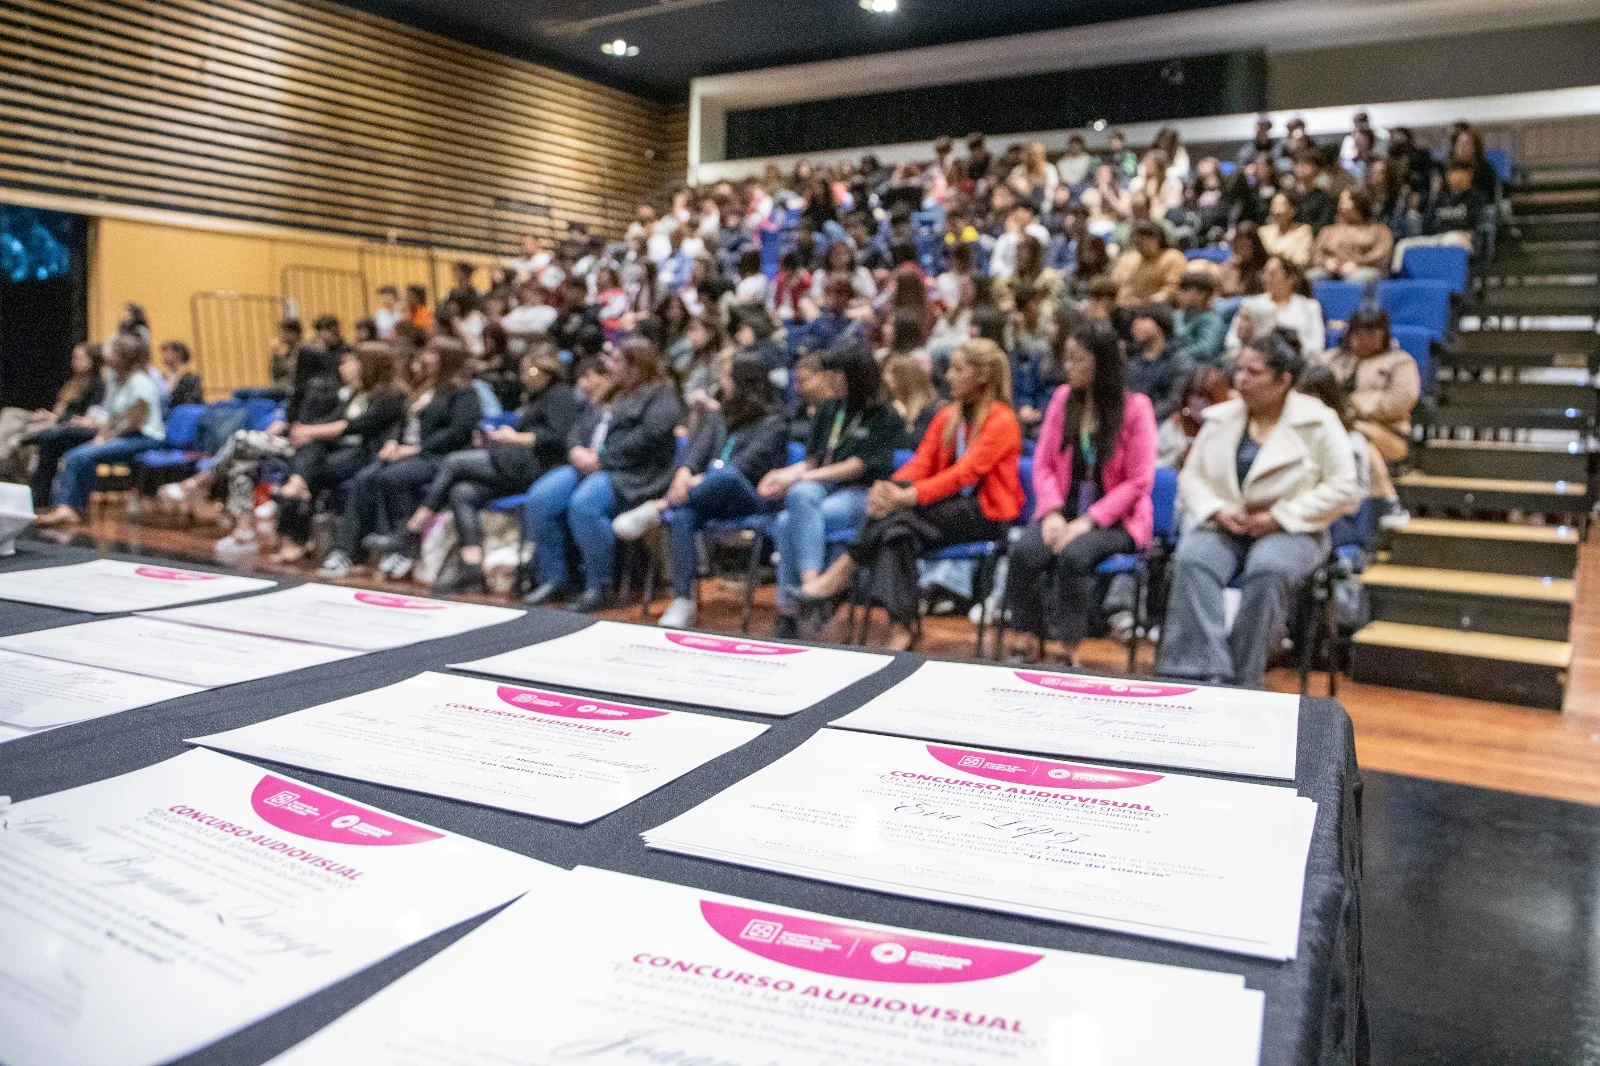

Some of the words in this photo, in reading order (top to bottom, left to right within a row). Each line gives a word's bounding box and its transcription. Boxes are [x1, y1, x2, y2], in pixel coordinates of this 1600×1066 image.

[446, 702, 525, 719] CONCURSO
[526, 716, 633, 737] AUDIOVISUAL
[890, 770, 1001, 792] CONCURSO
[1004, 786, 1154, 812] AUDIOVISUAL
[903, 778, 961, 790] camino
[997, 791, 1069, 806] igualdad
[894, 800, 961, 821] Eva
[168, 805, 253, 838] CONCURSO
[246, 834, 364, 881] AUDIOVISUAL
[1061, 847, 1106, 857] Puesto
[1045, 856, 1080, 865] ruido
[633, 953, 795, 992] CONCURSO
[801, 985, 1025, 1033] AUDIOVISUAL
[903, 1018, 934, 1032] de
